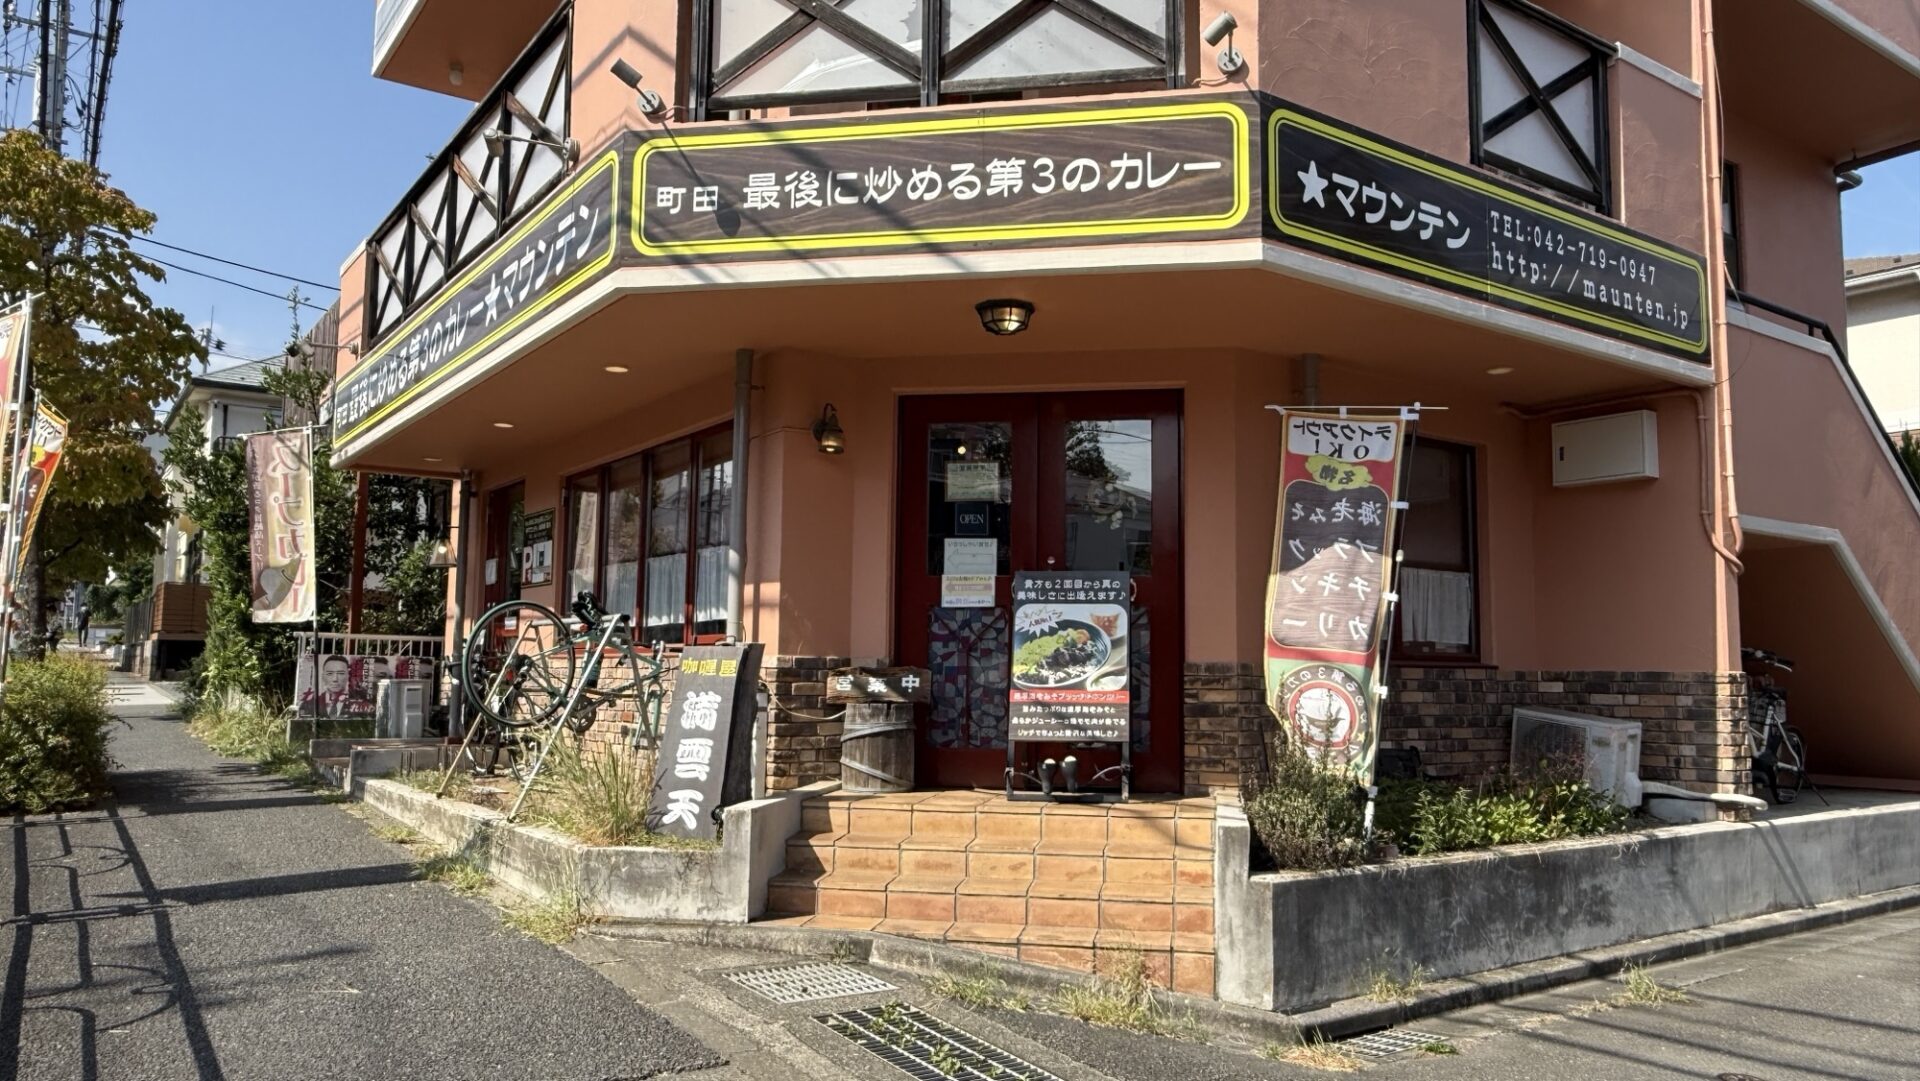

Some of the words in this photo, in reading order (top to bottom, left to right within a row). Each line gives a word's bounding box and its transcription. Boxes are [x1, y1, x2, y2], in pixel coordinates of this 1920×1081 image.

[657, 185, 718, 214] 町田
[742, 150, 1221, 211] 最後に炒める第3のカレー
[1490, 210, 1656, 286] TEL:042-719-0947
[959, 513, 985, 525] OPEN
